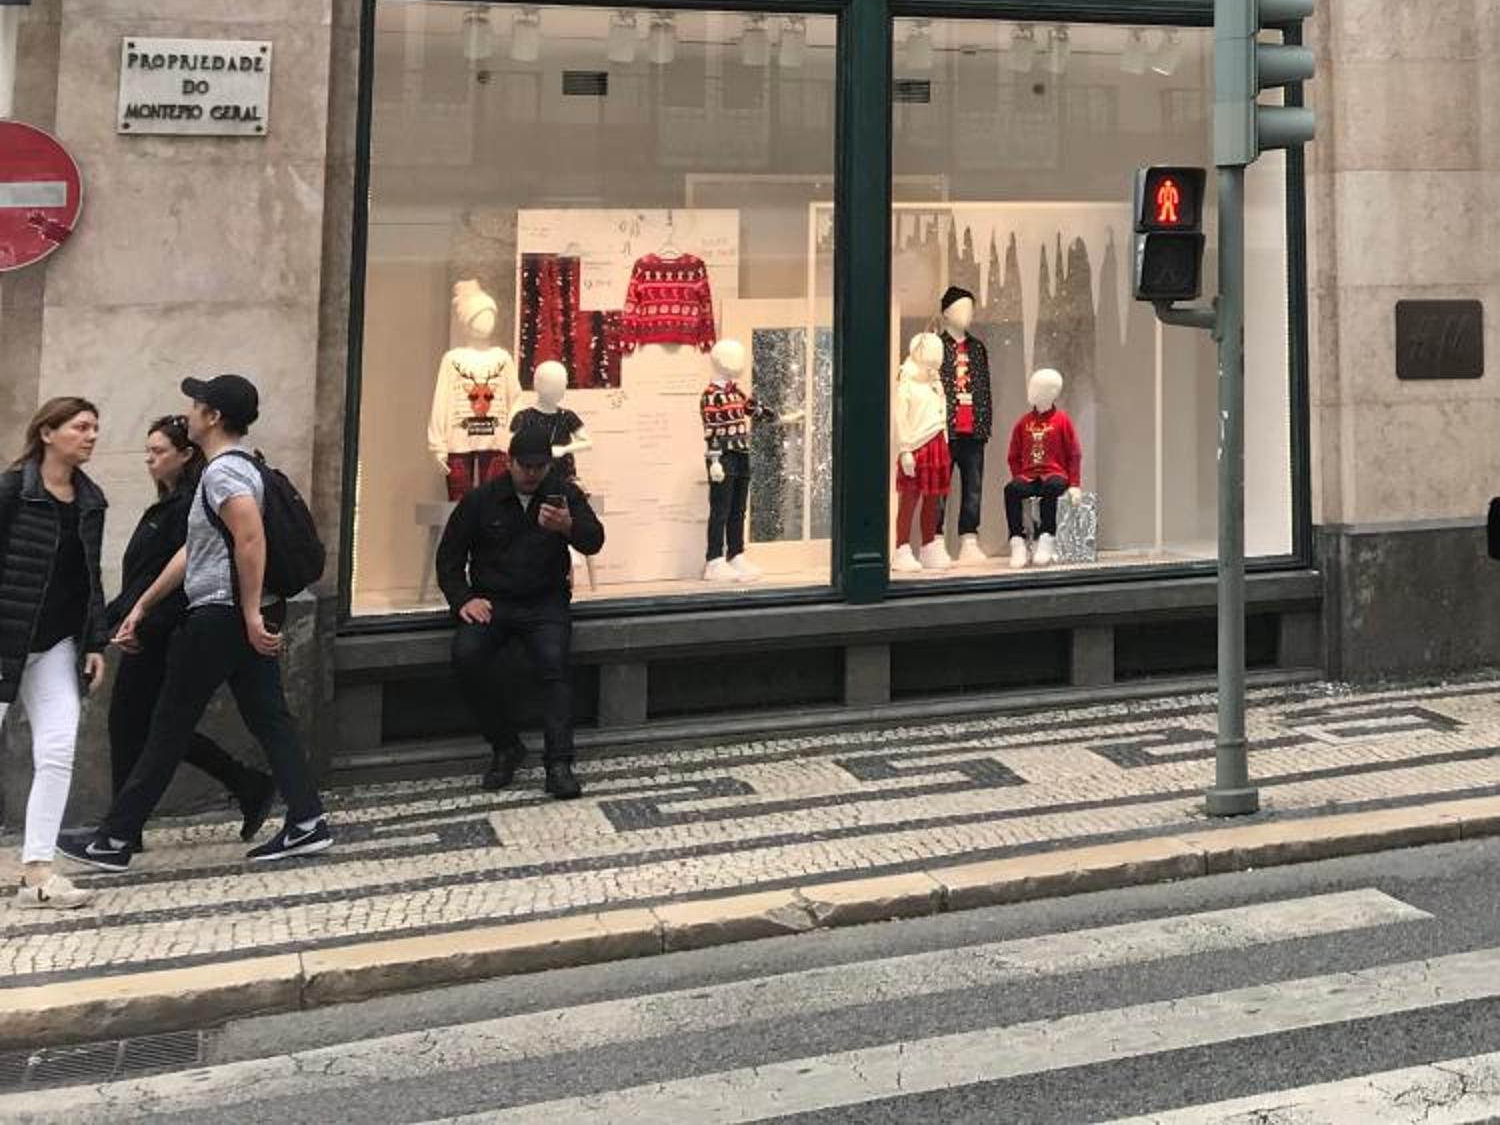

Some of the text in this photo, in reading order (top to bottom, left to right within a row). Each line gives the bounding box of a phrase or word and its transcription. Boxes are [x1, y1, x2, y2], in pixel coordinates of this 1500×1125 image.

[127, 52, 264, 71] PROPRIEDADE
[182, 80, 209, 95] DO
[124, 104, 262, 121] MONTEPIO GERAL
